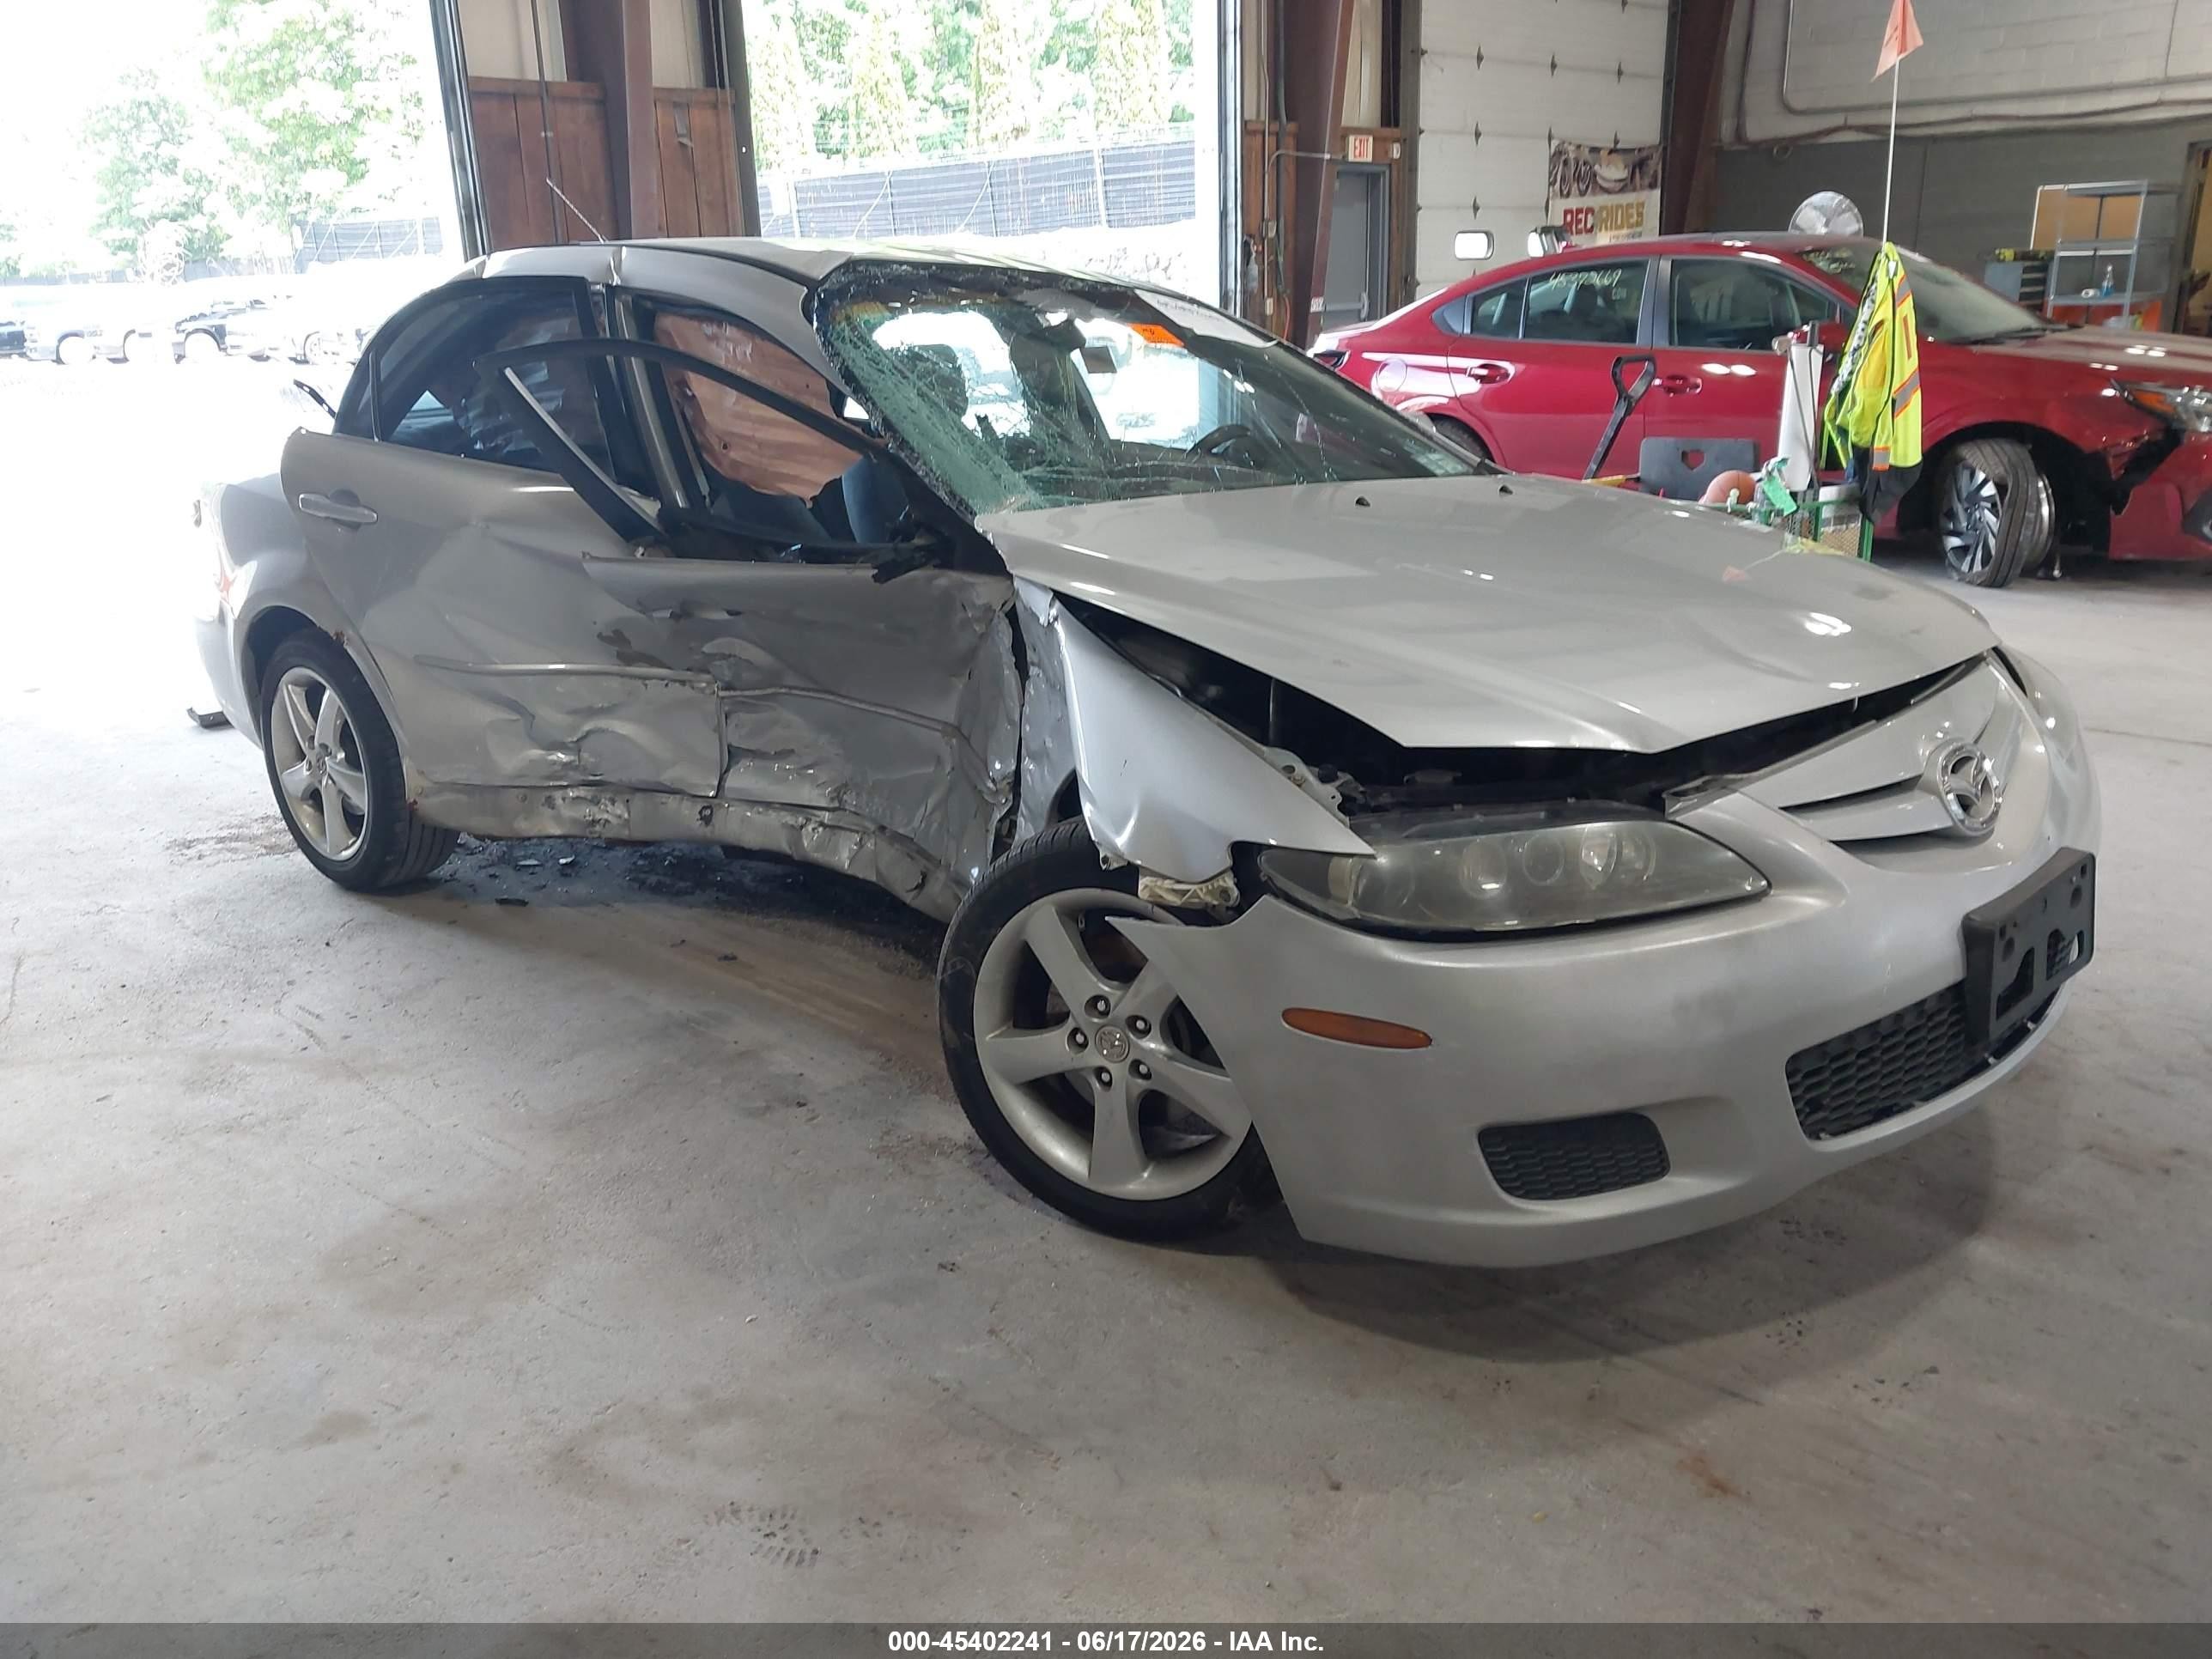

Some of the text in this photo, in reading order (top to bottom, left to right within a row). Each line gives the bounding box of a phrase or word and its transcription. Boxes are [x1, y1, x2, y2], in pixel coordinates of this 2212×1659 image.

[1353, 137, 1370, 158] EXIT
[1563, 201, 1645, 236] REC RIDES
